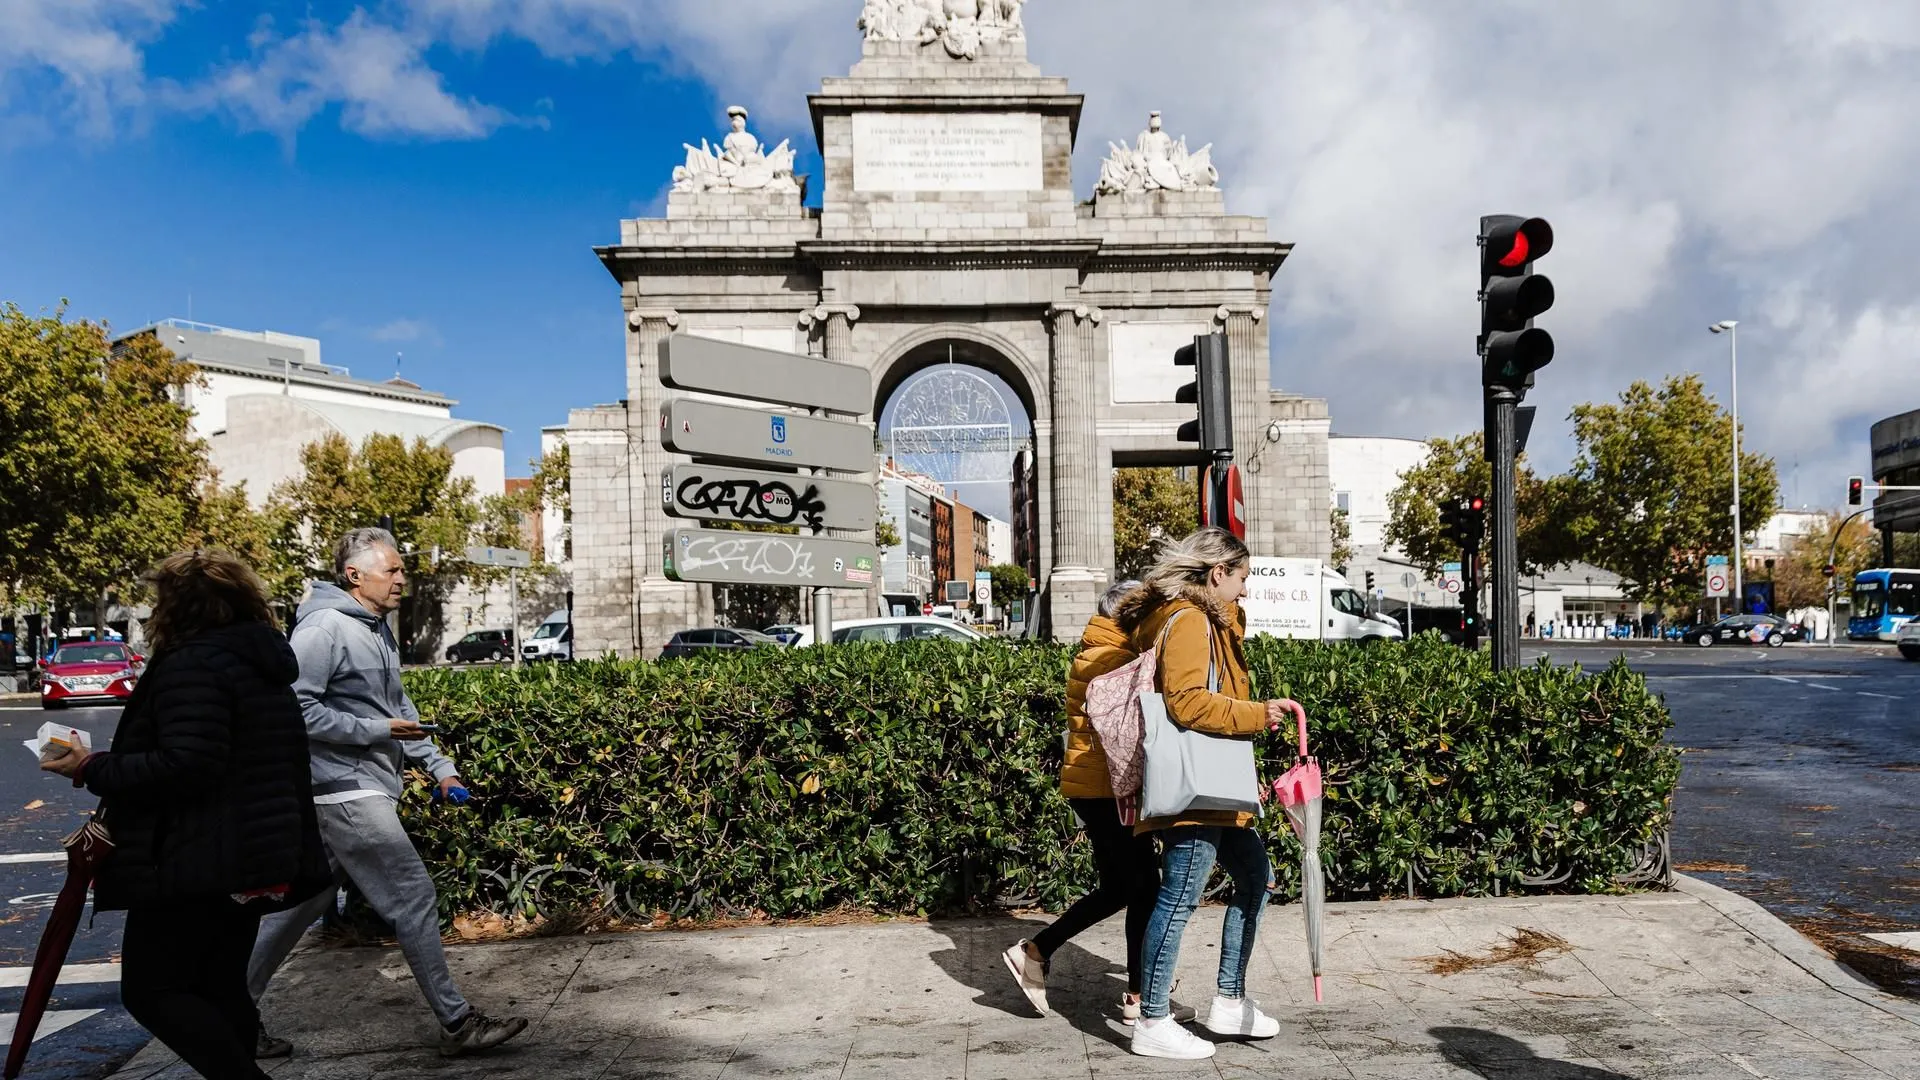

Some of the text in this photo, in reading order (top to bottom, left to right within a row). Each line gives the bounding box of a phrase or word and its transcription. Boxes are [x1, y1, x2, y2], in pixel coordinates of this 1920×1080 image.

[765, 447, 793, 457] MADRID
[775, 496, 792, 505] MO
[1263, 588, 1286, 604] Hijos
[1291, 589, 1311, 602] C.B.
